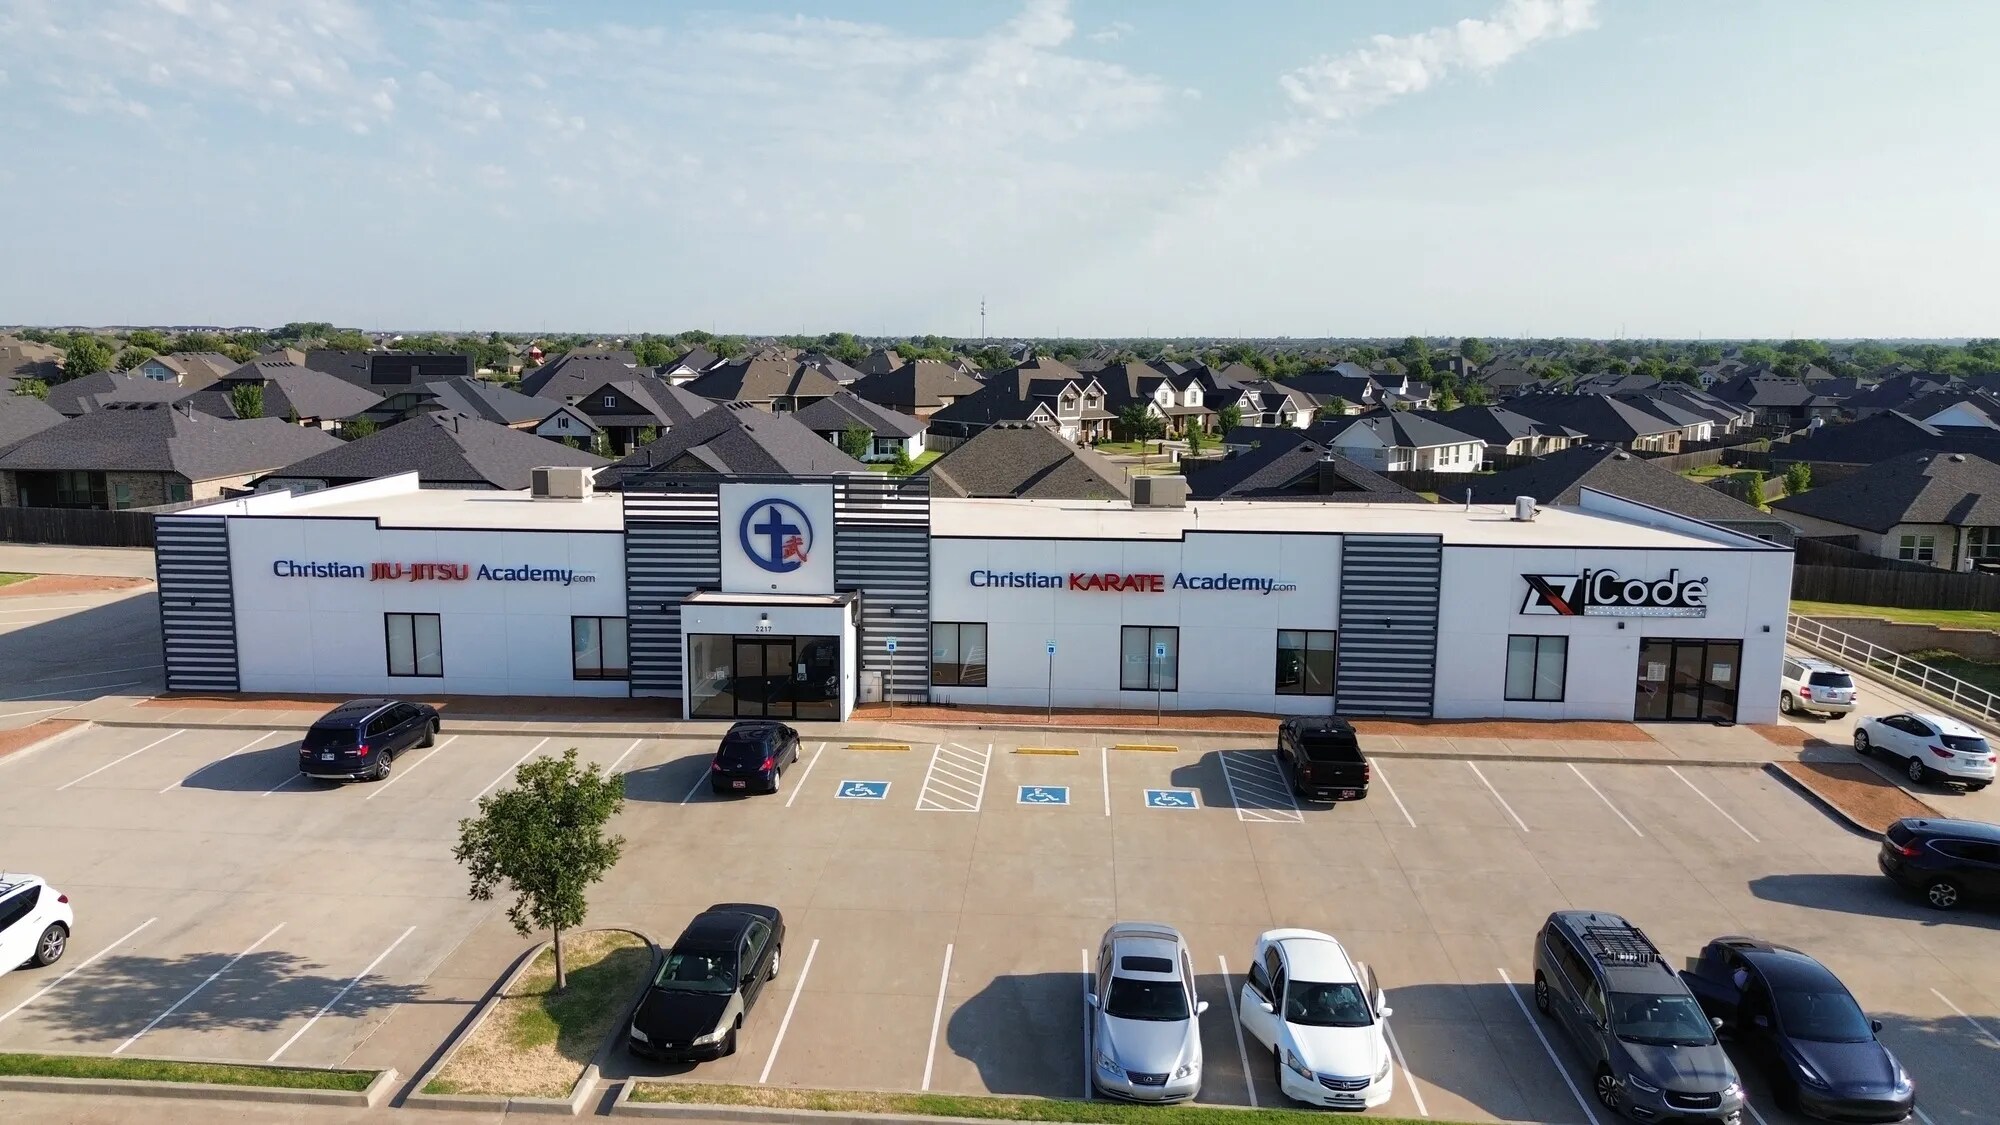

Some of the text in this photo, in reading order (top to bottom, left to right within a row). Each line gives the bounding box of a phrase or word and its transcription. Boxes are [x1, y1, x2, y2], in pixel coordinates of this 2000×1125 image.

[273, 560, 364, 578] Christian
[370, 562, 468, 582] JIU-JITSU
[971, 570, 1063, 588] Christian
[1069, 573, 1165, 593] KARATE
[1583, 568, 1708, 606] iCode
